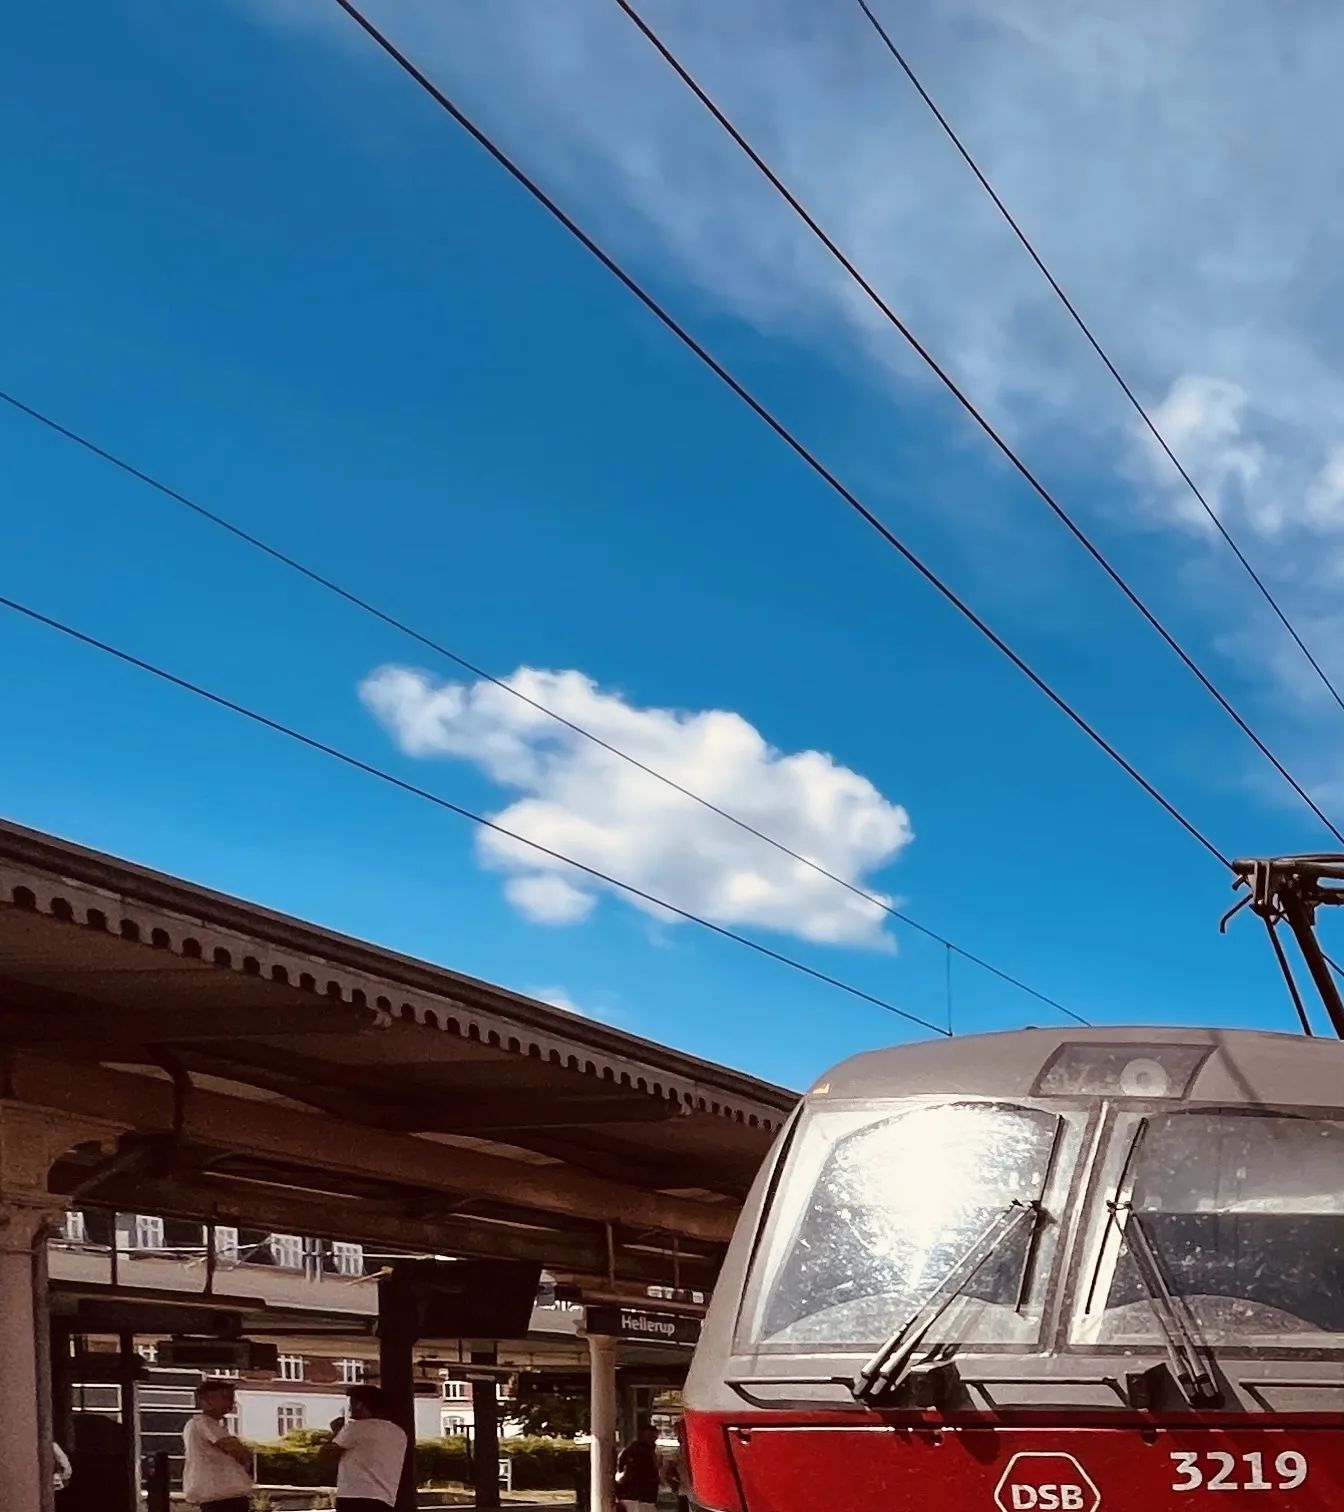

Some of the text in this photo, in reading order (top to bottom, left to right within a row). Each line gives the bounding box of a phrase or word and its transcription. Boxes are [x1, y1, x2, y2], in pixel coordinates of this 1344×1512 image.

[620, 1314, 676, 1337] Hellerup
[1170, 1450, 1308, 1492] 3219
[1010, 1483, 1084, 1511] DSB
